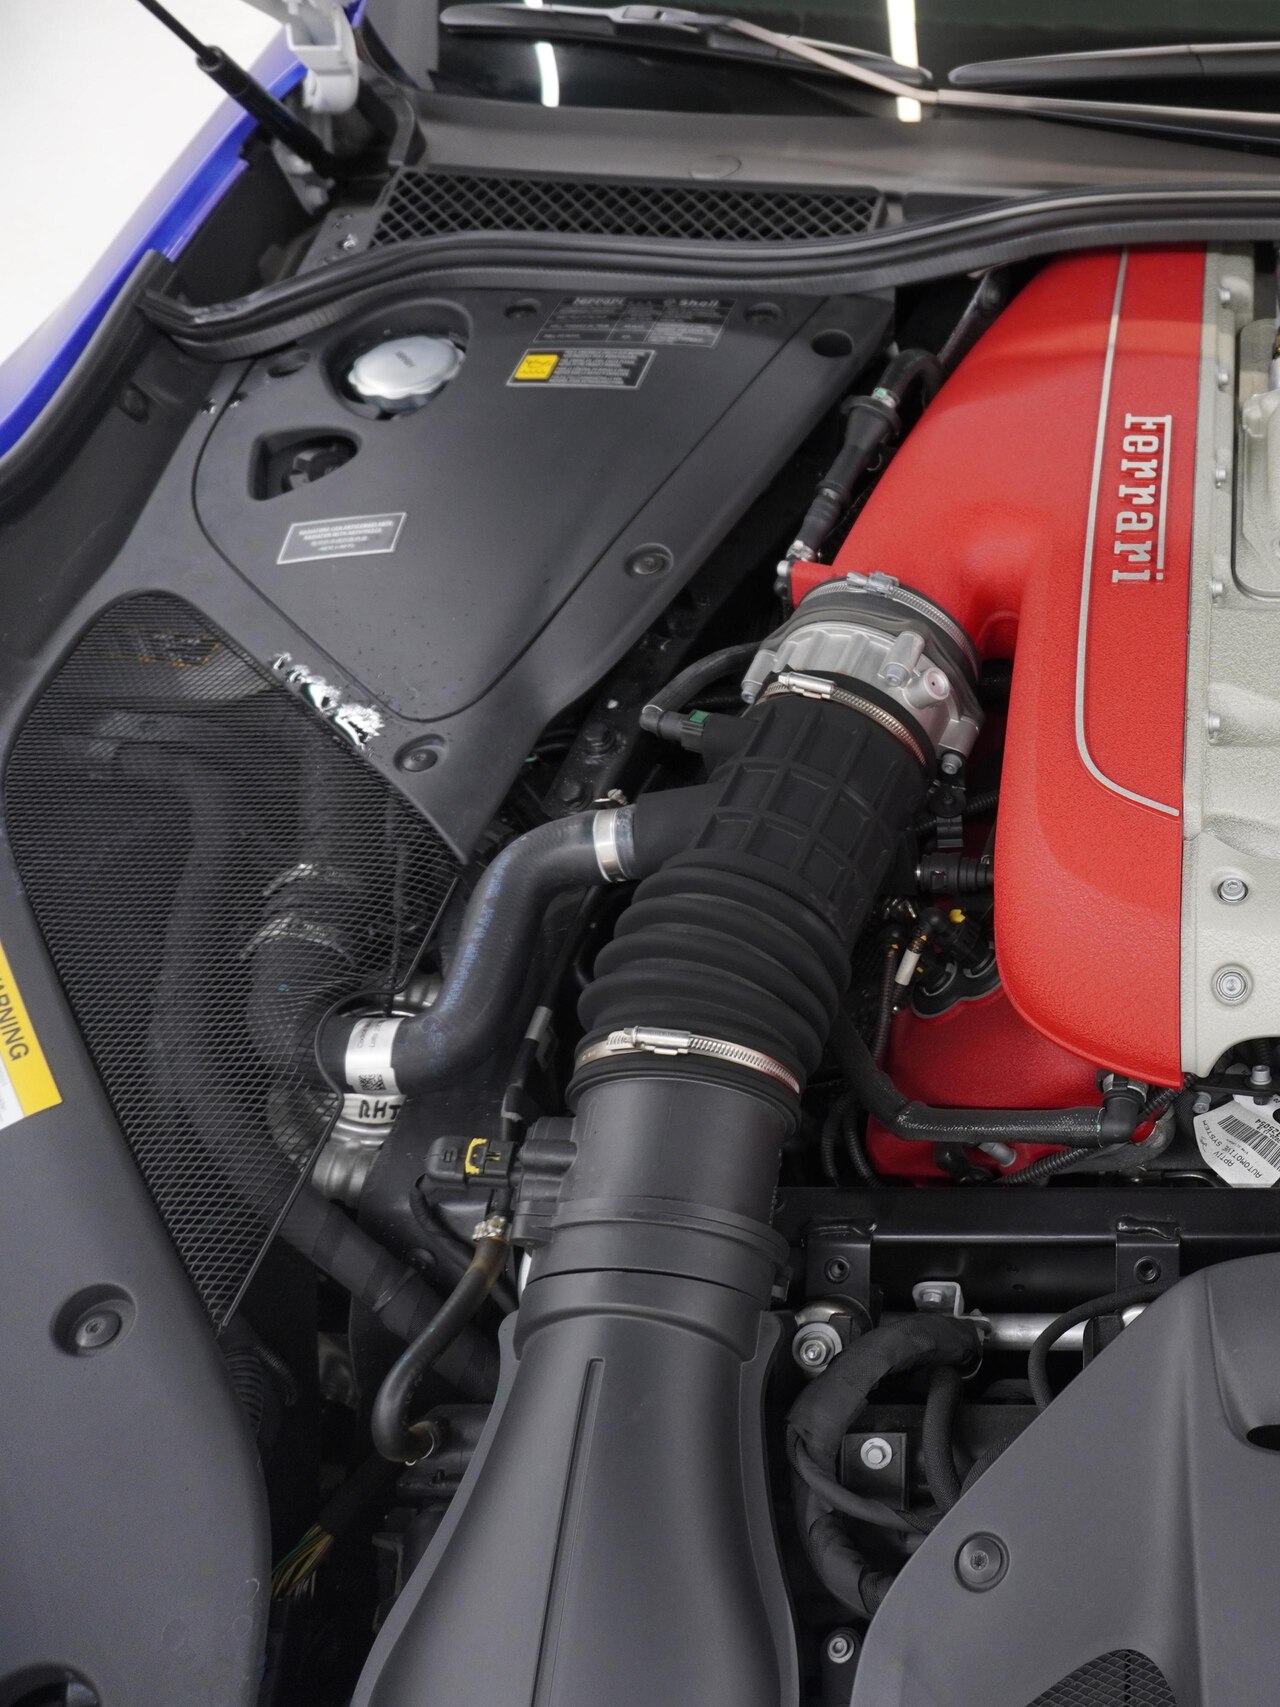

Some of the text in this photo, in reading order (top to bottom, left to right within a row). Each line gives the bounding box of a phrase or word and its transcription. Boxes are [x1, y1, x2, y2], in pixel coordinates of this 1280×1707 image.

[1111, 413, 1173, 584] Ferrari
[0, 977, 30, 1062] RNING
[358, 1099, 400, 1120] RHT
[1202, 1119, 1223, 1147] SYSTEM
[1213, 1151, 1235, 1167] APTIV
[1222, 1145, 1262, 1179] AUTOMOTIVE
